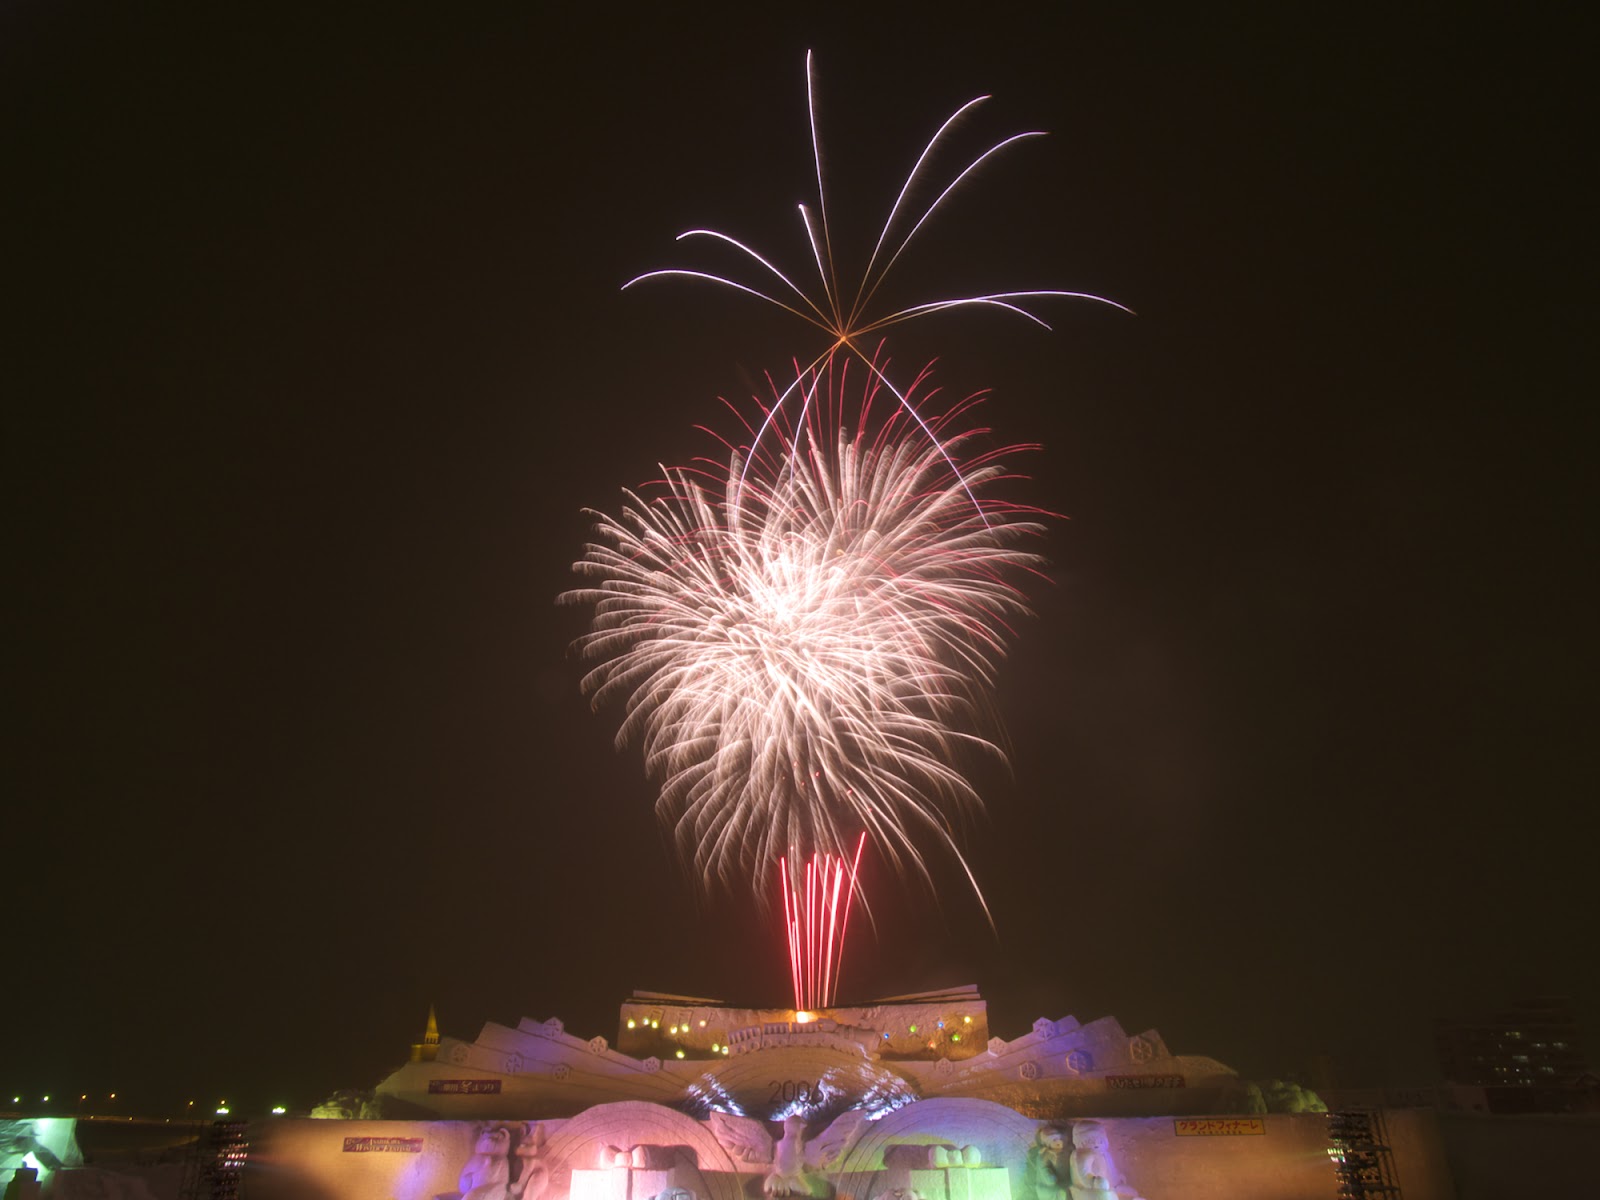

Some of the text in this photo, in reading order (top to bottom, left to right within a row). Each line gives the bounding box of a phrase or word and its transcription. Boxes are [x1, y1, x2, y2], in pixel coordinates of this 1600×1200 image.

[1180, 1120, 1258, 1131] グランドフィナーレ
